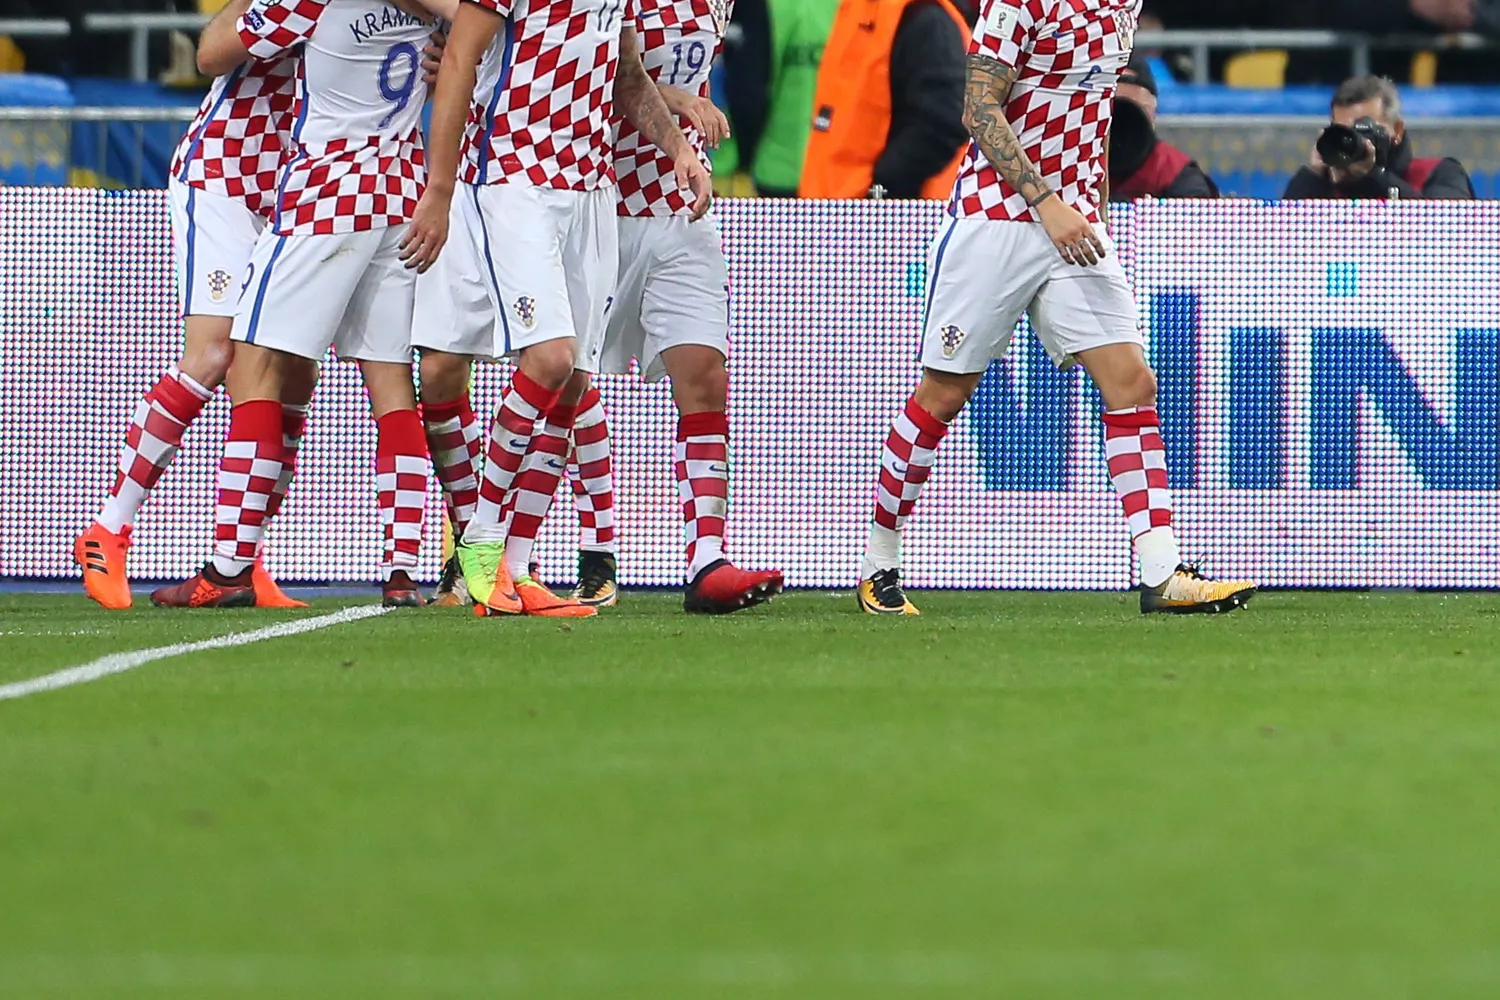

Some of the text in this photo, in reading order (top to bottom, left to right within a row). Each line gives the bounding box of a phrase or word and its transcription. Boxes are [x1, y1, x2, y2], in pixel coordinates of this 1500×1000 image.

[670, 41, 707, 85] 19
[1078, 65, 1102, 90] 2
[377, 41, 420, 132] 9
